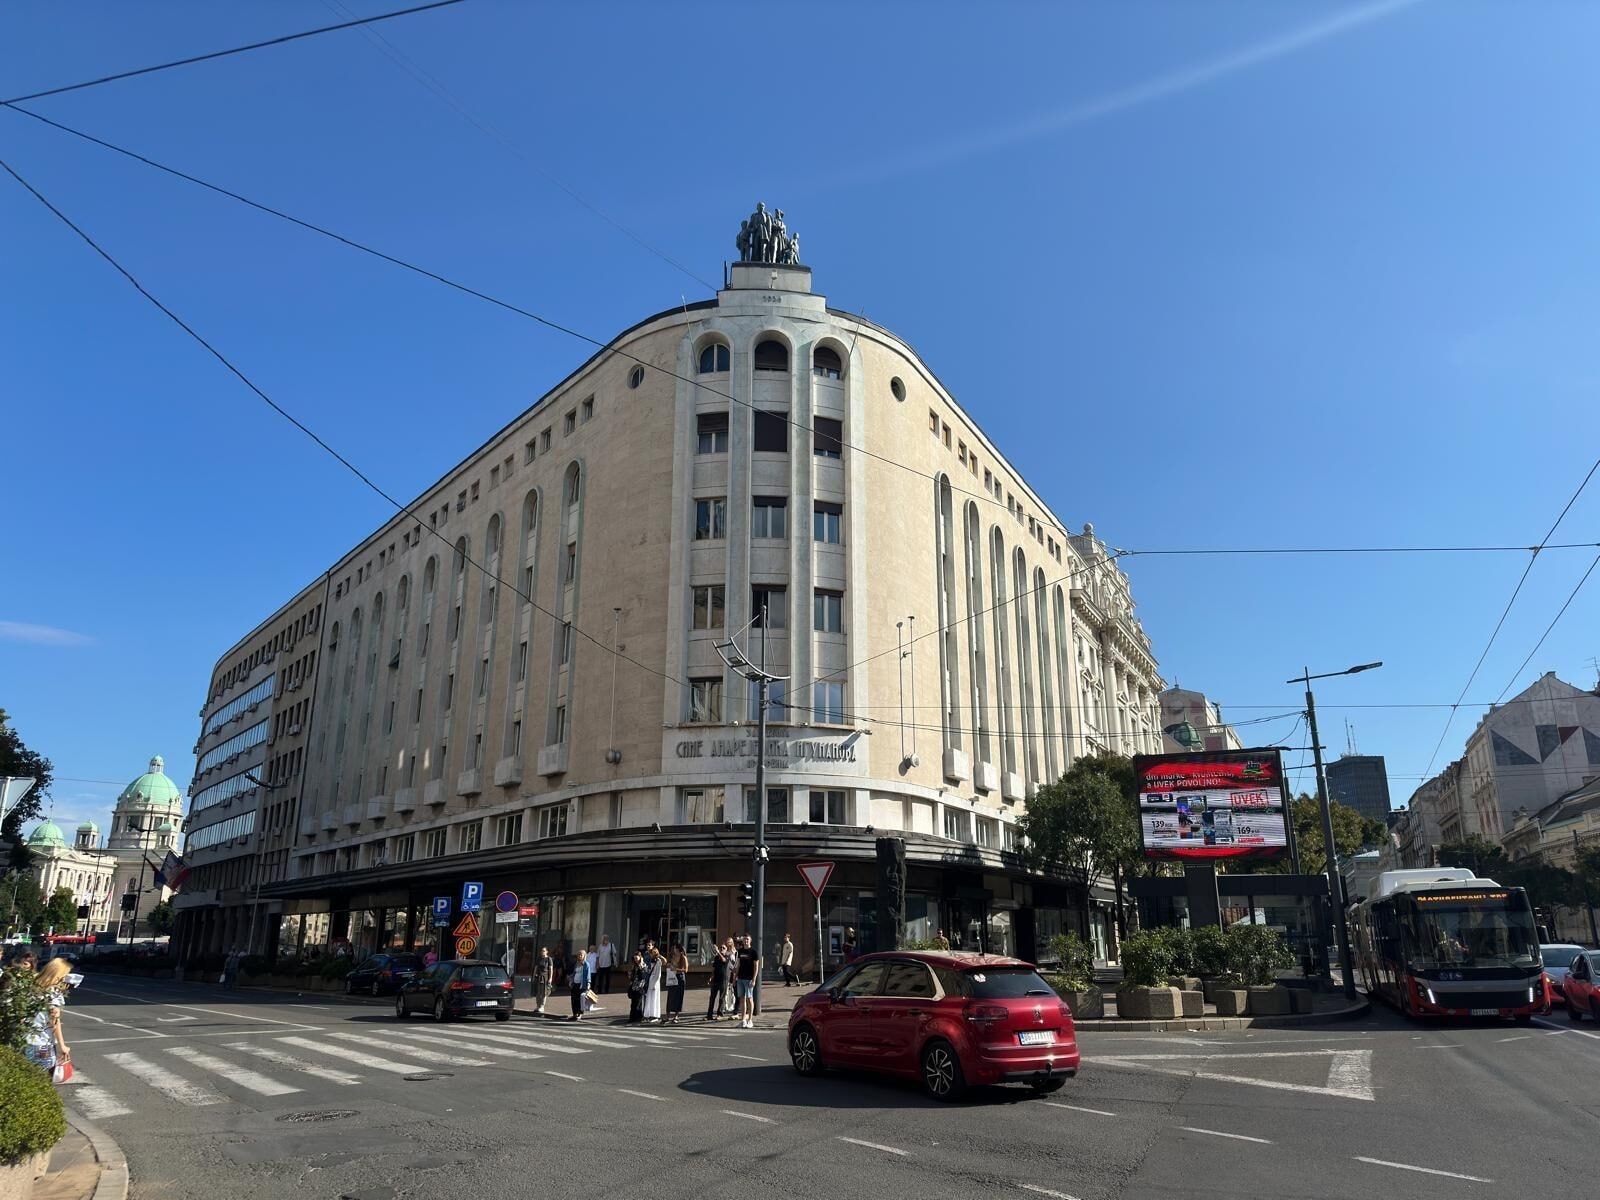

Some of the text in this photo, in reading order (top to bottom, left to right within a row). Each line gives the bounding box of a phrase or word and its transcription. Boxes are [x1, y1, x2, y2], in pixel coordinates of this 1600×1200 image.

[1153, 780, 1175, 789] UVEK
[1233, 793, 1263, 805] UVEK
[1151, 820, 1165, 830] 139
[1237, 826, 1251, 834] 169
[467, 885, 478, 898] P
[437, 899, 447, 912] P
[460, 940, 472, 951] 40
